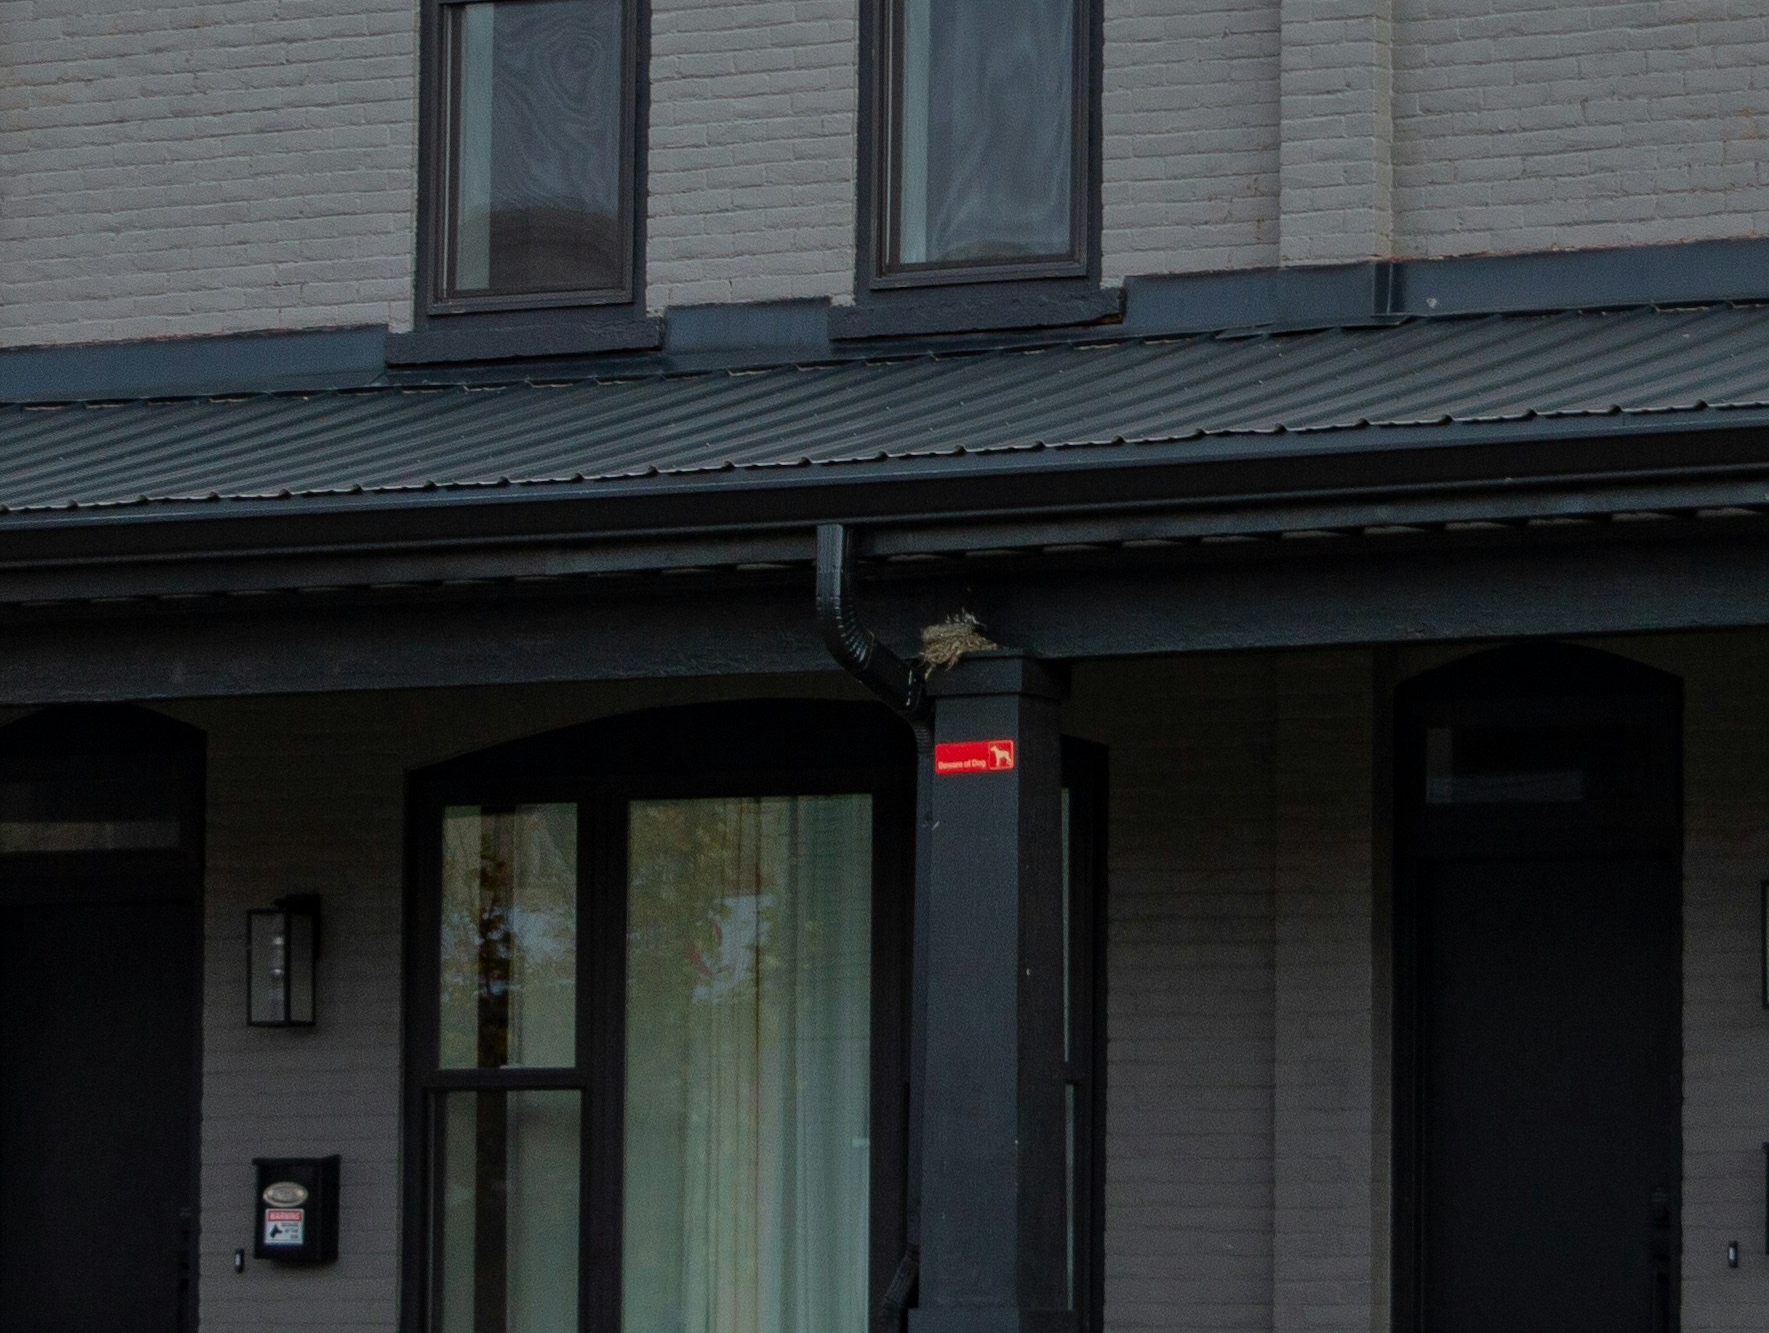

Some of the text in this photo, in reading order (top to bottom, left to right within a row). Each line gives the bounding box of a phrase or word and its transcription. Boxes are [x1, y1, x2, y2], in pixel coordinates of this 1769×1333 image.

[938, 758, 986, 770] Beware of Dog
